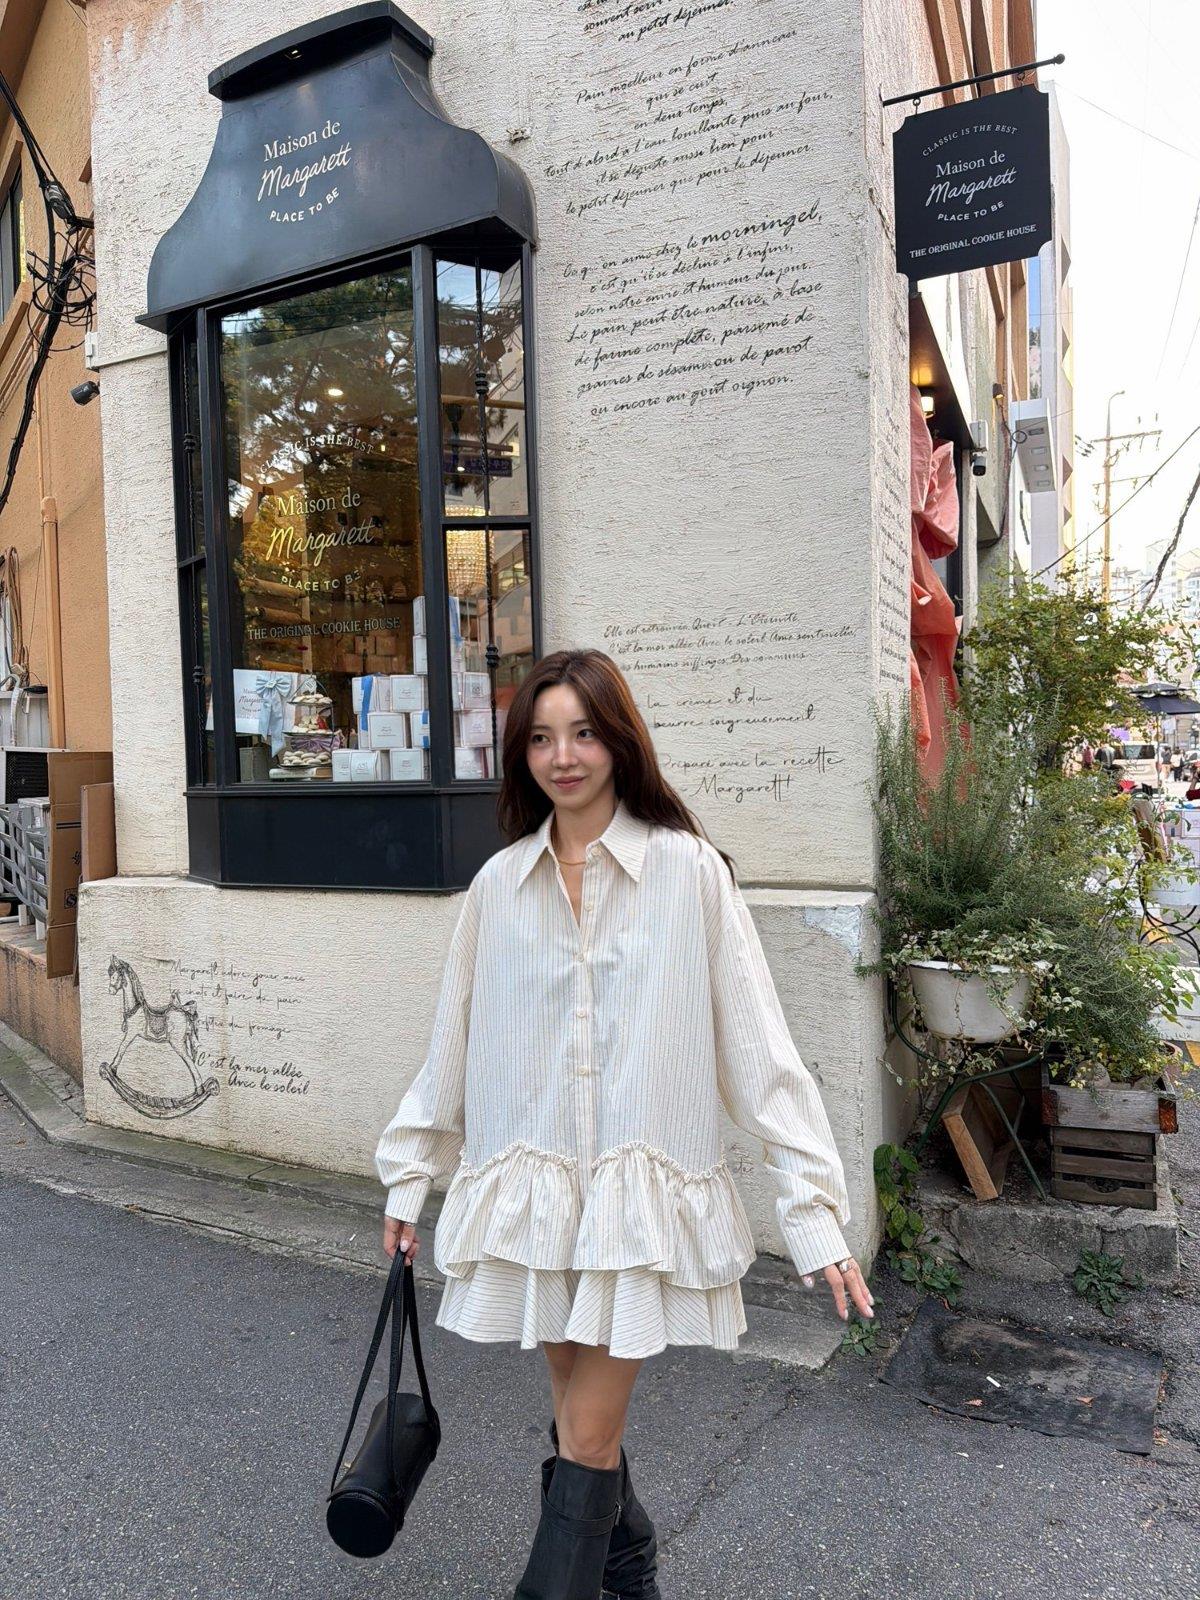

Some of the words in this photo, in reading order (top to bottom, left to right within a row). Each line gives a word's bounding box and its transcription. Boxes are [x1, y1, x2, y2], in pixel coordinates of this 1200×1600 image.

[636, 13, 671, 41] petit
[576, 89, 605, 104] Pain
[264, 130, 318, 162] Maison
[322, 120, 341, 139] de
[922, 131, 958, 157] CLASSIC
[961, 127, 970, 136] IS
[973, 124, 992, 134] THE
[995, 124, 1018, 135] BEST
[258, 141, 352, 202] Margarett
[935, 157, 985, 178] Maison
[989, 150, 1006, 166] de
[925, 167, 1017, 207] Margarett
[269, 209, 305, 222] PLACE
[309, 202, 323, 215] TO
[326, 187, 339, 204] BE
[937, 212, 970, 222] PLACE
[973, 208, 987, 218] TO
[991, 201, 1005, 212] BE
[909, 248, 927, 259] THE
[928, 238, 971, 255] ORIGINAL
[971, 231, 1005, 245] COOKIE
[1006, 224, 1037, 237] HOUSE
[306, 435, 316, 448] IS
[320, 433, 343, 446] THE
[347, 437, 375, 455] BEST
[278, 495, 337, 517] Maison
[341, 486, 361, 508] de
[265, 519, 375, 567] Margarett
[281, 575, 319, 591] PLACE
[324, 578, 341, 591] TO
[248, 627, 268, 641] THE
[269, 623, 319, 639] ORIGINAL
[321, 620, 362, 636] COOKIE
[364, 616, 400, 630] HOUSE
